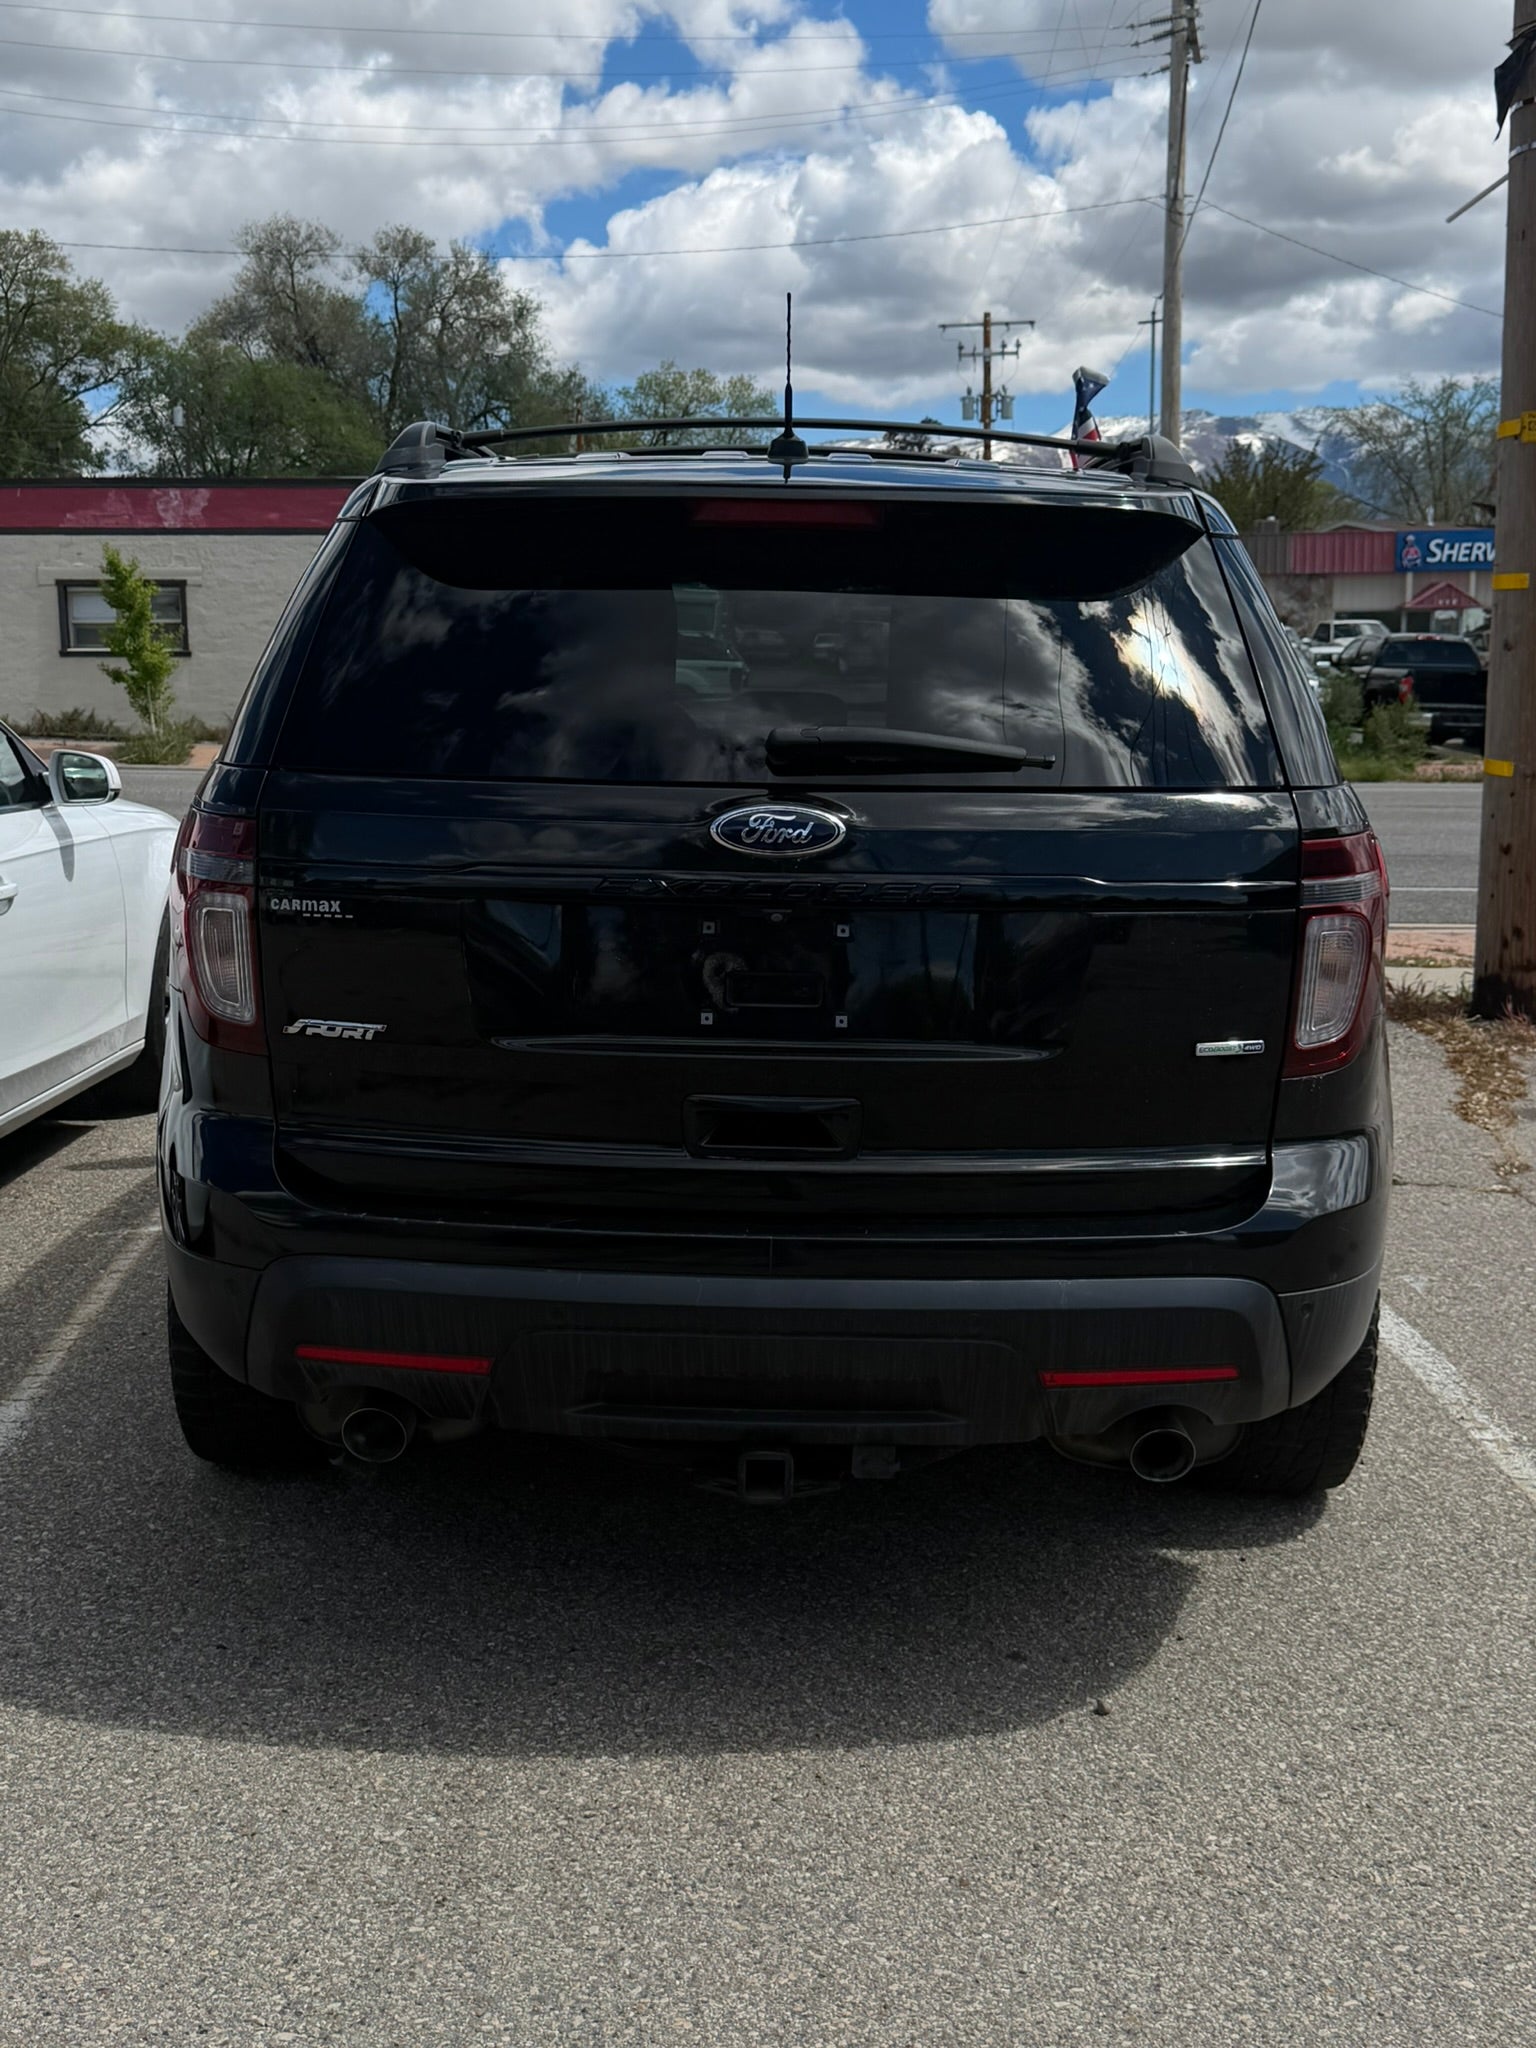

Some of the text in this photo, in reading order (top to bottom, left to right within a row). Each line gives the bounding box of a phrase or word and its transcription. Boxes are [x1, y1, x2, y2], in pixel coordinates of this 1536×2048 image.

[741, 813, 815, 844] Ford
[593, 878, 961, 901] EXPLORER
[282, 1018, 388, 1041] SPORT
